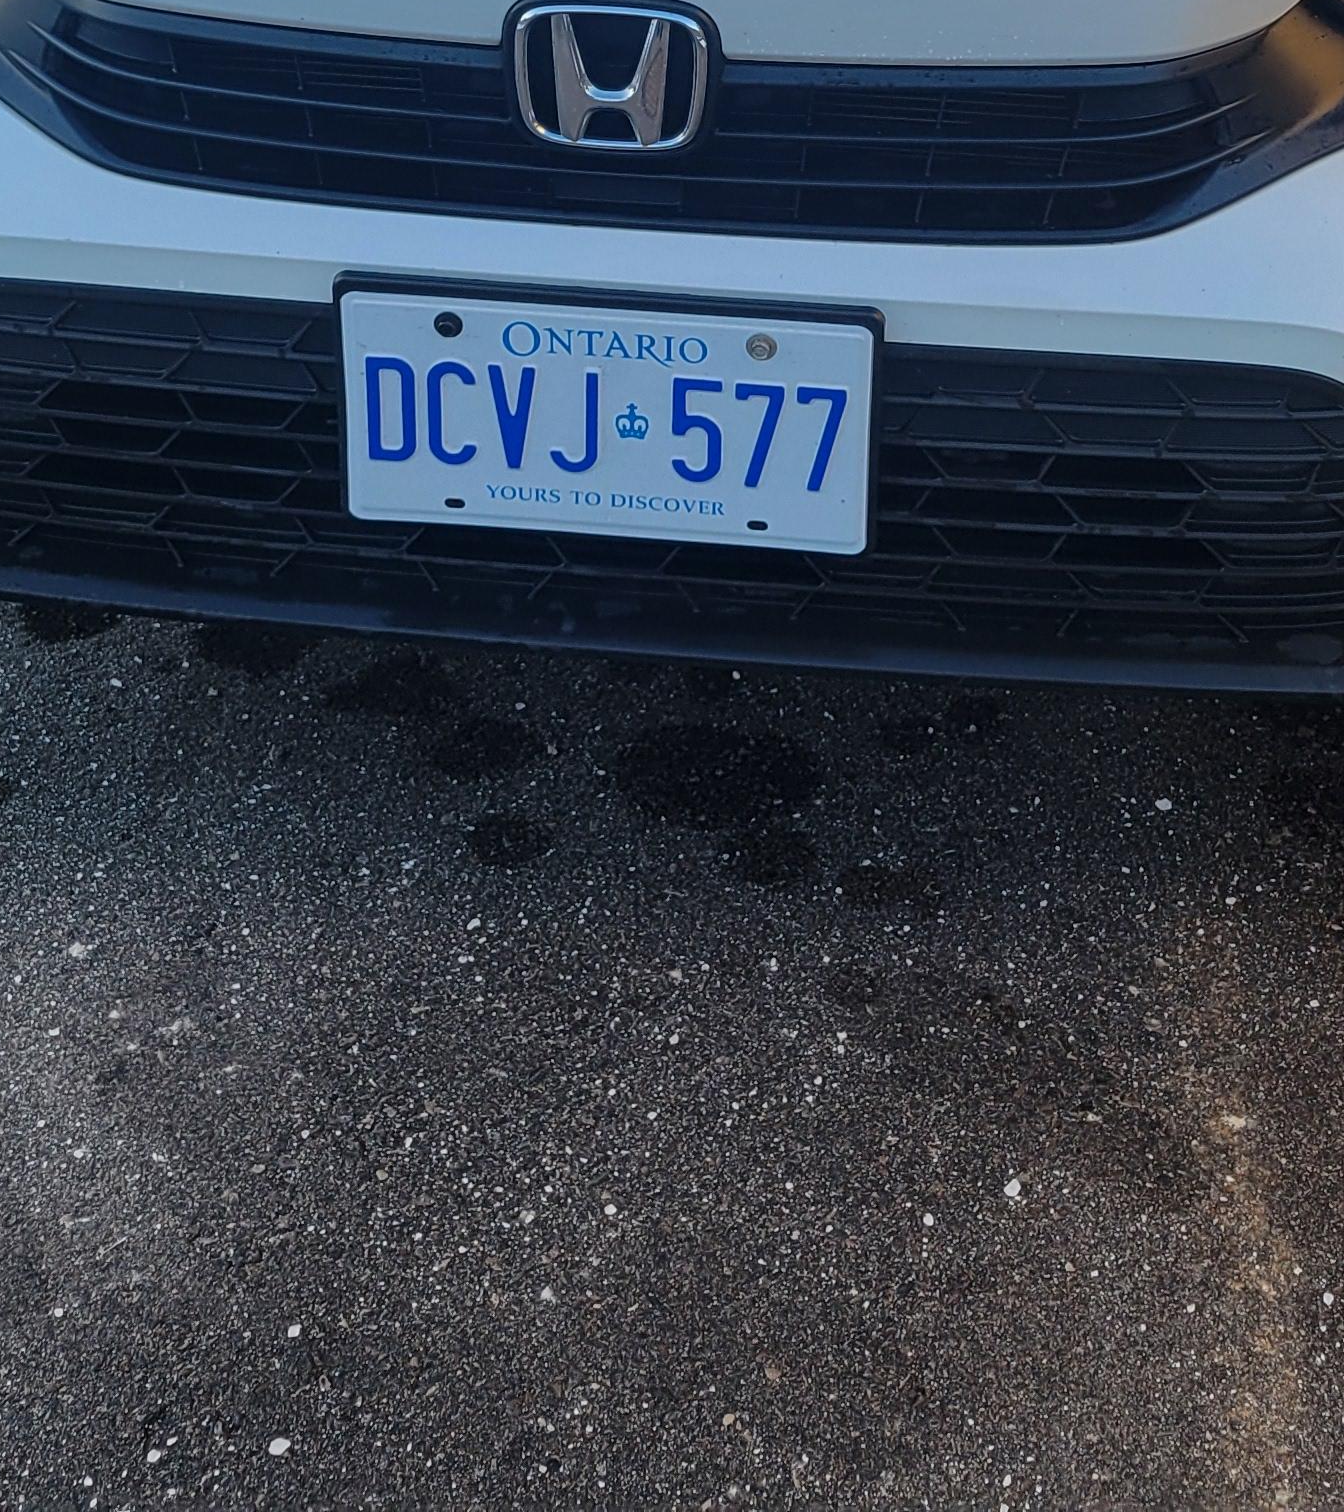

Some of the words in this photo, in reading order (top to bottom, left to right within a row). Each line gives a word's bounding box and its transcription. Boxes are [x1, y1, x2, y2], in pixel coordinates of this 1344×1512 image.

[364, 355, 599, 473] DCVJ
[671, 376, 848, 492] 577
[486, 484, 561, 504] YOURS
[569, 490, 601, 507] TO
[610, 493, 725, 516] DISCOVER
